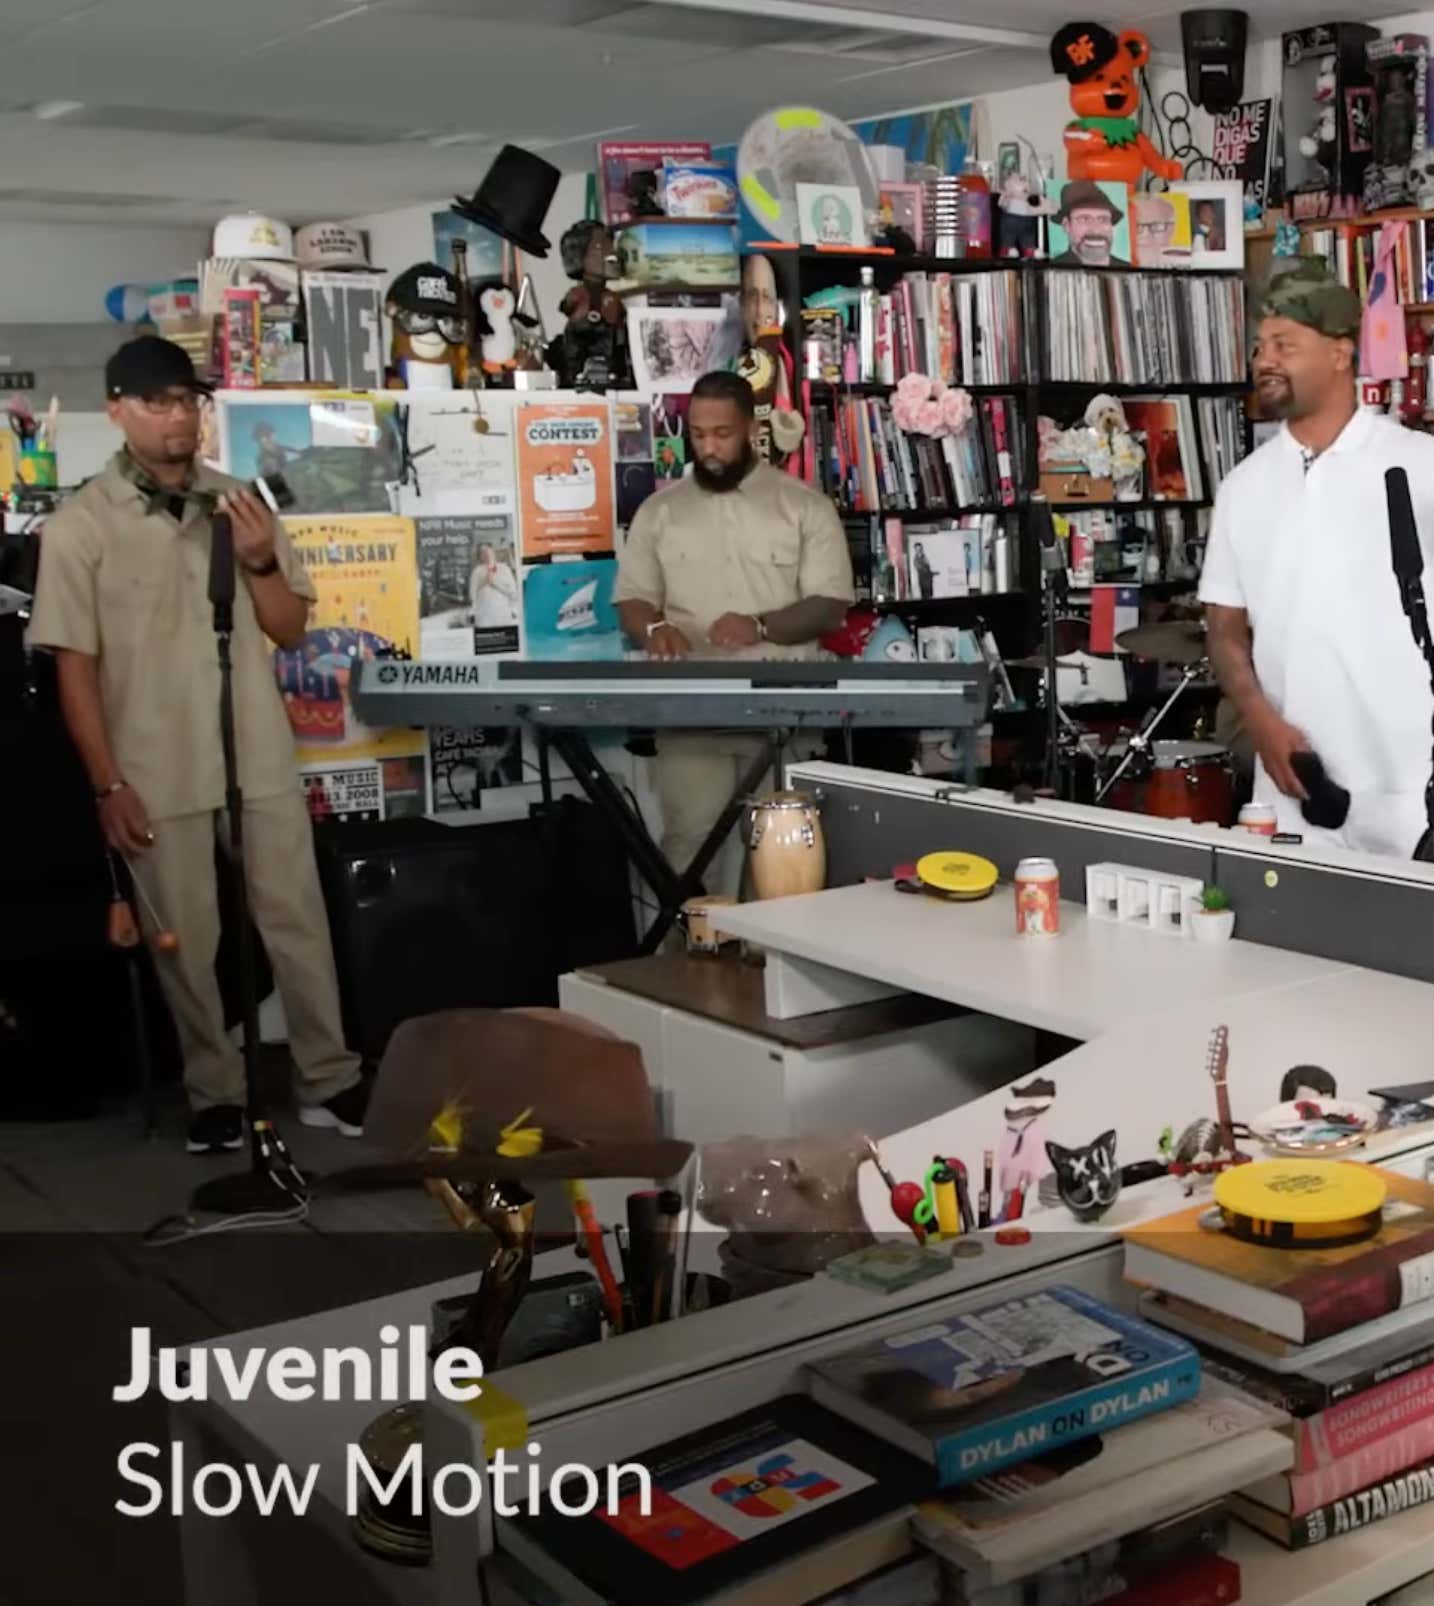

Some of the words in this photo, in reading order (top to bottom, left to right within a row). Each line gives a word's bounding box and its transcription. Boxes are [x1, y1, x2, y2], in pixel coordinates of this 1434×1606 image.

[1216, 106, 1241, 126] NO
[1243, 102, 1266, 122] ME
[1215, 122, 1260, 147] DIGAS
[1213, 144, 1247, 166] QUE
[528, 427, 600, 441] CONTEST
[420, 537, 446, 548] your
[296, 543, 397, 566] NNIERSARY
[400, 665, 479, 685] YAMAHA
[332, 771, 379, 785] MUSIC
[347, 788, 379, 800] 2008
[960, 1423, 1048, 1470] DYLAN
[1052, 1410, 1086, 1436] ON
[1090, 1379, 1170, 1424] DYLAN
